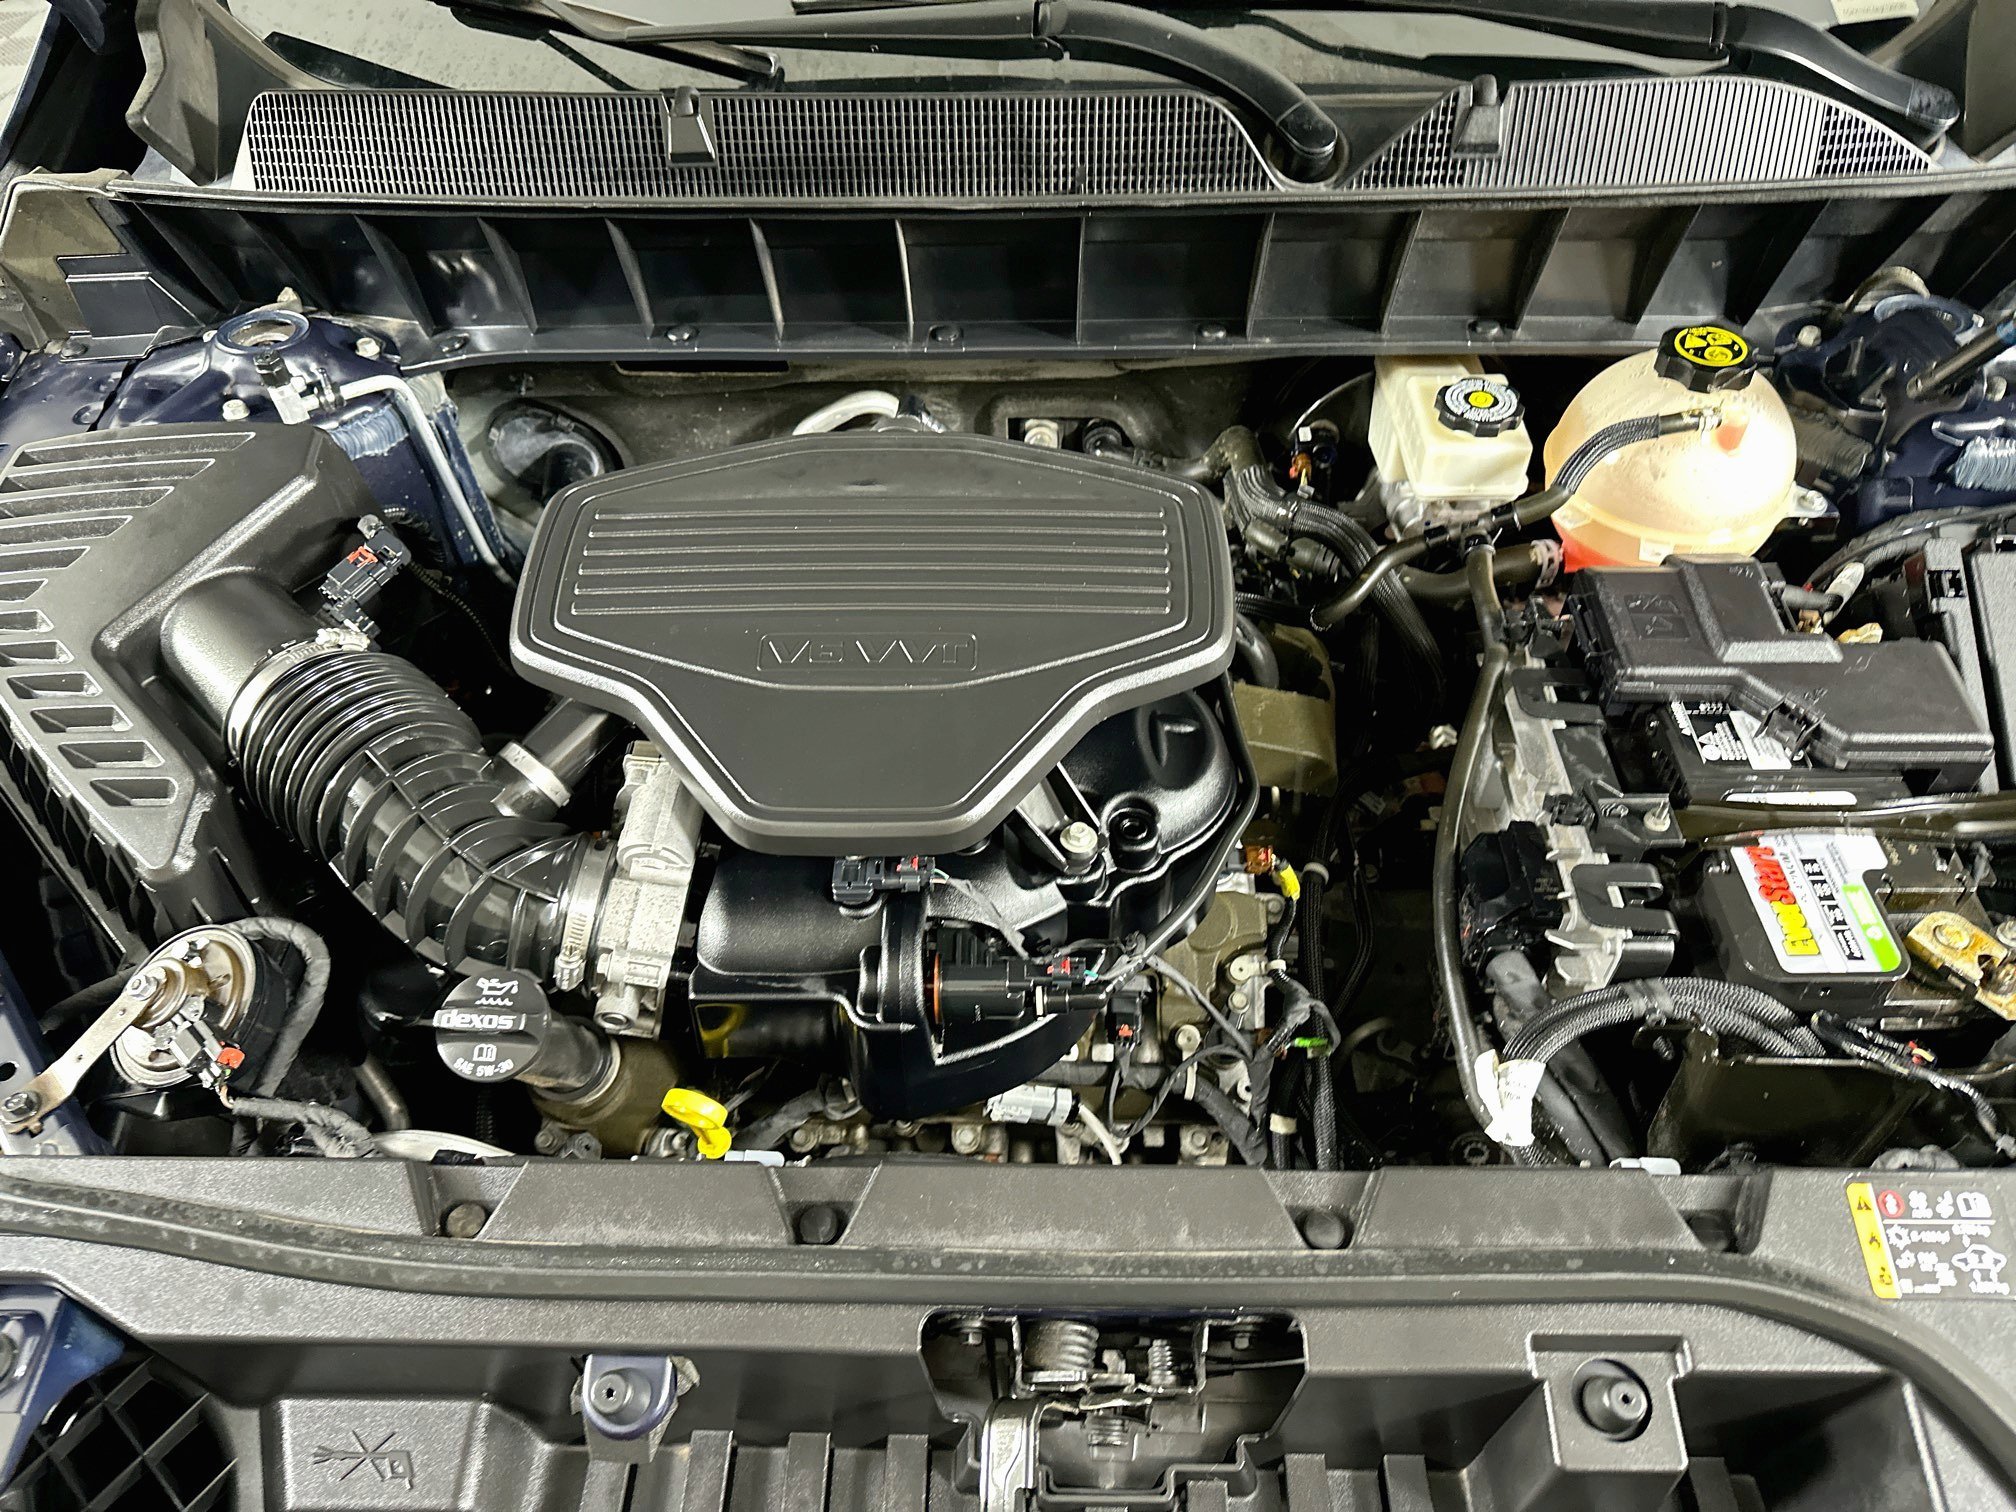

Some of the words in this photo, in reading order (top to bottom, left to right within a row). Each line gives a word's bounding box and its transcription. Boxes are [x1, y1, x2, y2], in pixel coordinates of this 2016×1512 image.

[769, 640, 845, 664] V6
[855, 640, 969, 664] VVT
[441, 1010, 517, 1030] dexos
[453, 1057, 475, 1075] SAE
[476, 1058, 515, 1077] 5W-30
